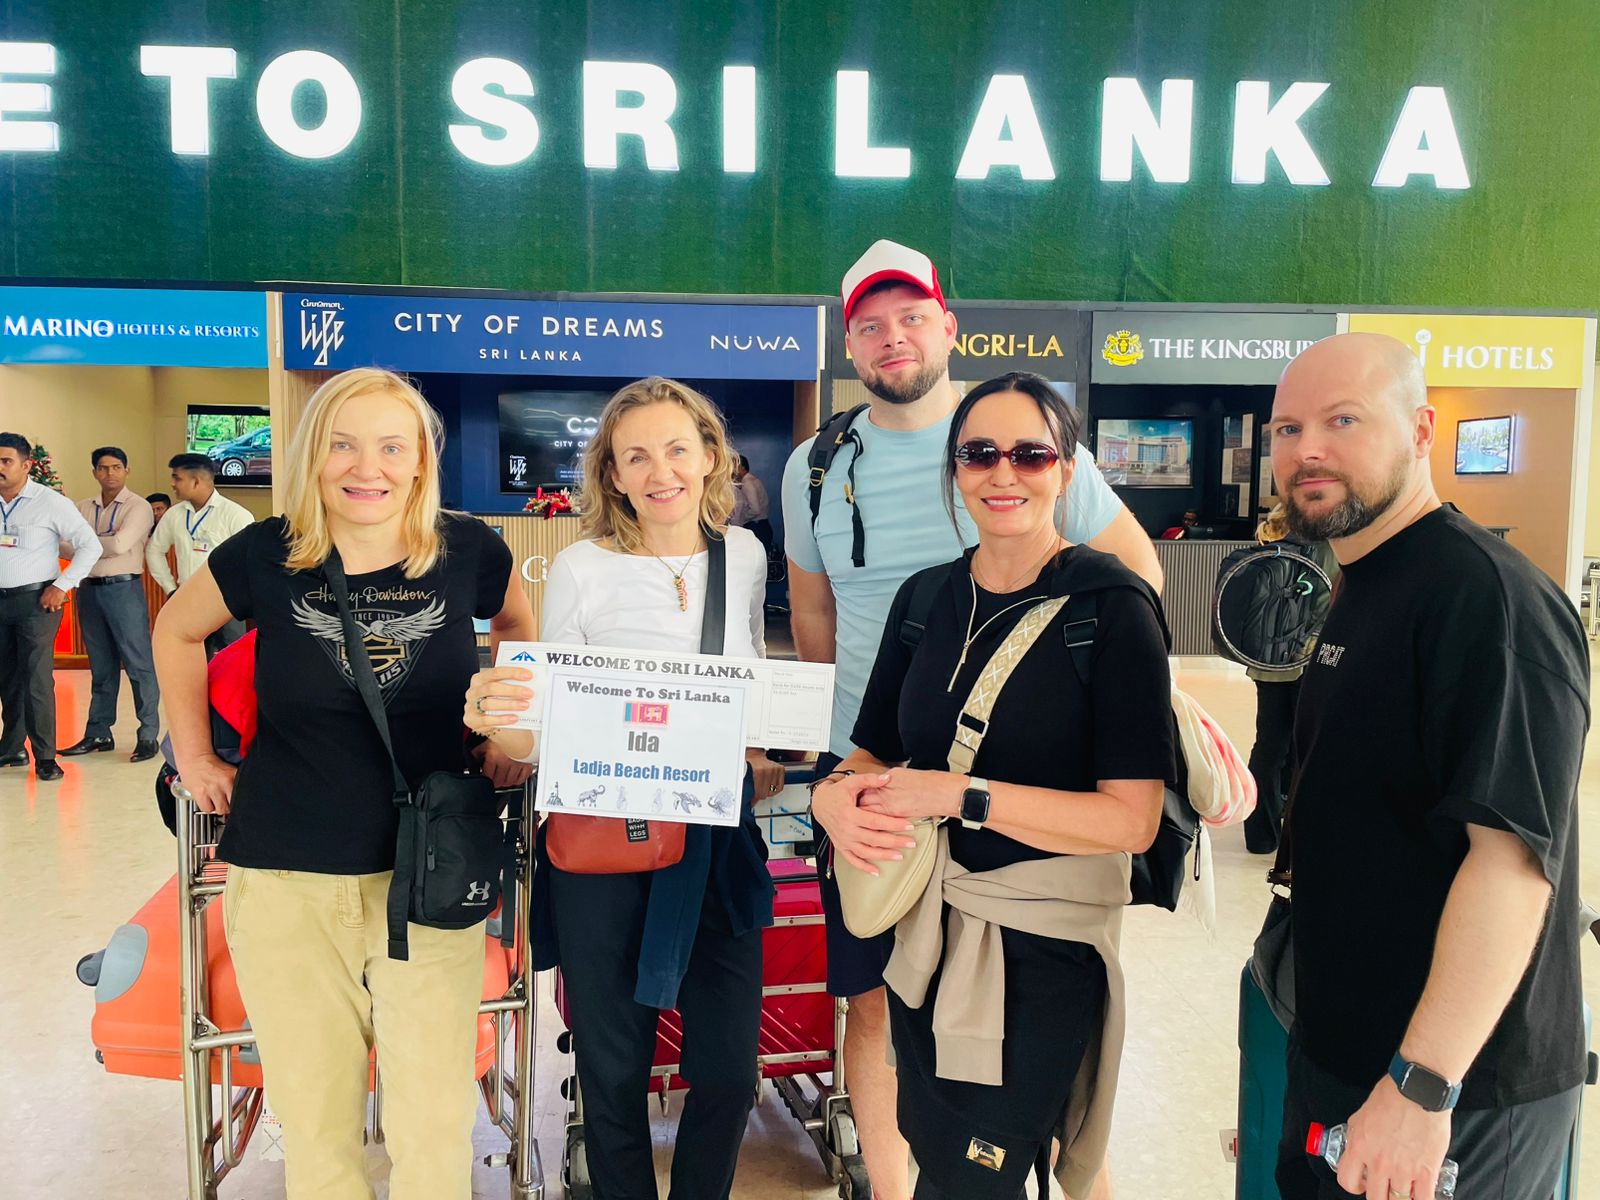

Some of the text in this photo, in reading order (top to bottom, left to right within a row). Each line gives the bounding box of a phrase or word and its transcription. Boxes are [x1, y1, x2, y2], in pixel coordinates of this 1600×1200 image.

[140, 45, 363, 159] TO
[448, 57, 757, 172] SRI
[834, 70, 1472, 190] LANKA
[4, 314, 260, 338] MARINO HOTELS & RESORTS
[394, 312, 664, 338] CITY OF DREAMS
[479, 348, 582, 362] SRI LANKA
[1148, 338, 1317, 360] THE KINGSBU
[1442, 345, 1554, 370] HOTELS
[553, 440, 573, 448] CITY
[304, 583, 435, 610] Hay-Davidson
[353, 613, 373, 621] INCE
[546, 652, 631, 670] WELCOME
[634, 659, 657, 673] TO
[661, 661, 691, 675] SRI
[694, 664, 755, 680] LANKA
[567, 681, 731, 704] Welcome To Sri Lanka
[627, 731, 660, 753] Ida
[573, 758, 711, 783] Ladja Beach Resort
